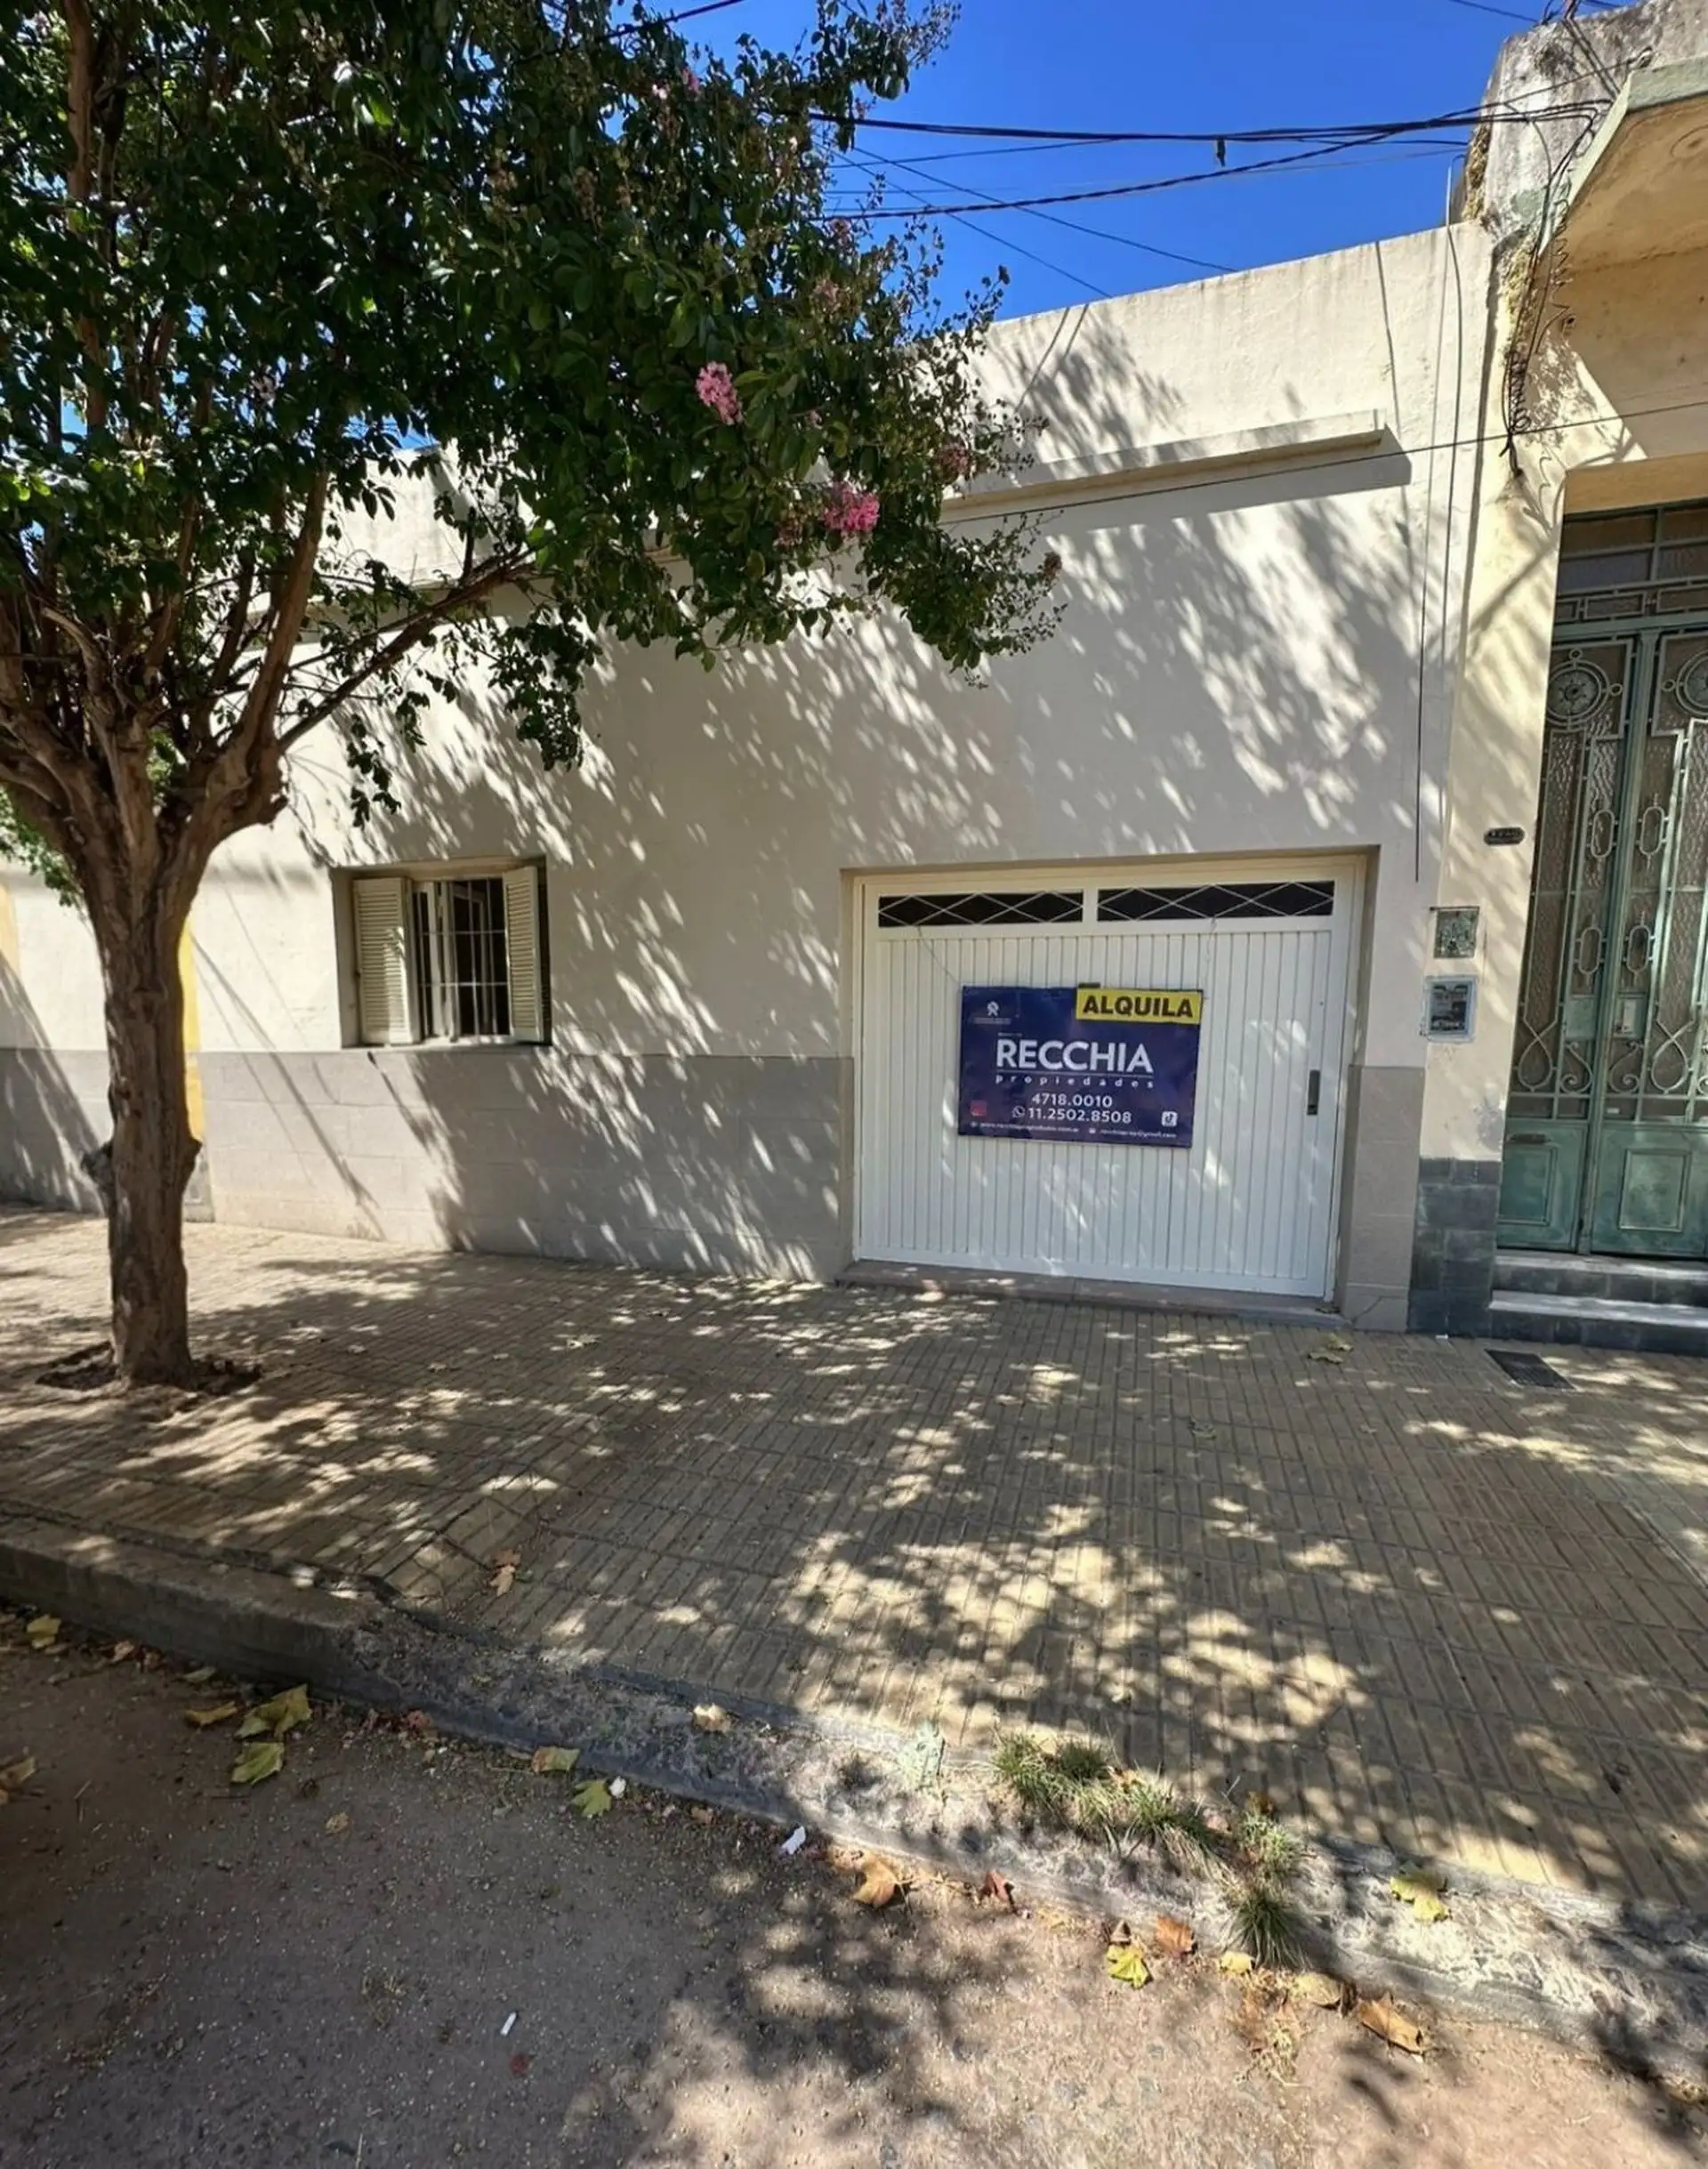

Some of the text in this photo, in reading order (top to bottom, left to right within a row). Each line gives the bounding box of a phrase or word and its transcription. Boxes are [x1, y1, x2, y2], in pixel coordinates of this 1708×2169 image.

[1083, 996, 1193, 1018] ALQUILA
[996, 1039, 1154, 1073] RECCHIA
[995, 1075, 1154, 1089] propiedades
[1032, 1093, 1113, 1109] 4718.0010
[1028, 1108, 1132, 1125] 11.2502.8508
